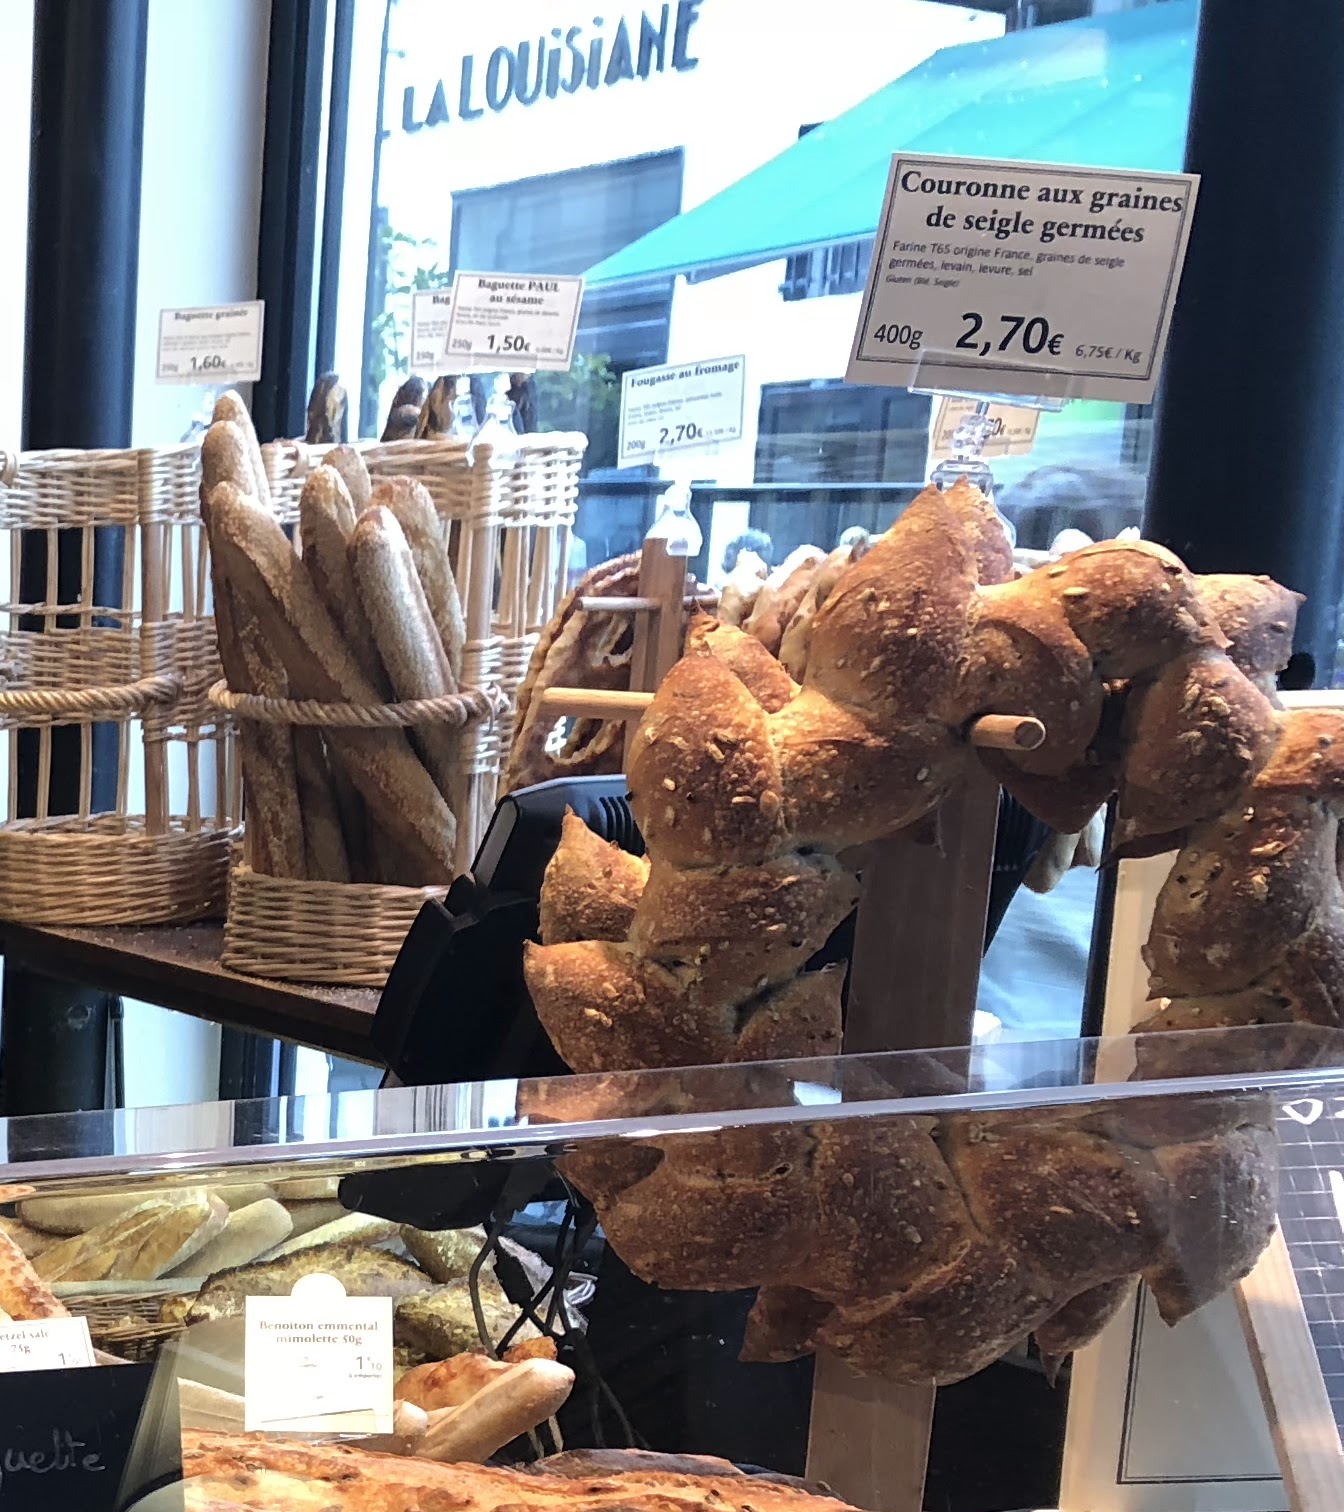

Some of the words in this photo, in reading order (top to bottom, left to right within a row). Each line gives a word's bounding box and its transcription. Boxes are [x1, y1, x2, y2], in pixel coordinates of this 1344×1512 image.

[402, 78, 449, 134] LA
[901, 170, 1030, 200] Couronne
[1038, 185, 1082, 205] aux
[1090, 186, 1183, 214] graines
[926, 205, 956, 229] de
[963, 210, 1034, 239] seigle
[1040, 218, 1145, 243] germées
[892, 241, 926, 252] Farine
[954, 245, 990, 258] origine
[1077, 255, 1091, 265] de
[478, 279, 525, 292] Baguette
[528, 282, 560, 292] PAUL
[506, 294, 544, 305] sésame
[488, 334, 531, 354] 1,50€
[874, 323, 923, 350] 400g
[956, 312, 1065, 357] 2,70€
[1075, 344, 1113, 360] 6,75€
[1115, 347, 1121, 359] /
[1124, 347, 1141, 364] Kg
[191, 355, 226, 371] 1,60€
[631, 372, 675, 388] Fougasse
[695, 362, 739, 375] fromage
[660, 422, 703, 445] 2,70€
[260, 1321, 314, 1330] Benoiton
[318, 1321, 378, 1330] emmental
[11, 1344, 30, 1354] 75g
[276, 1334, 338, 1343] mimolette
[343, 1335, 362, 1346] 50g
